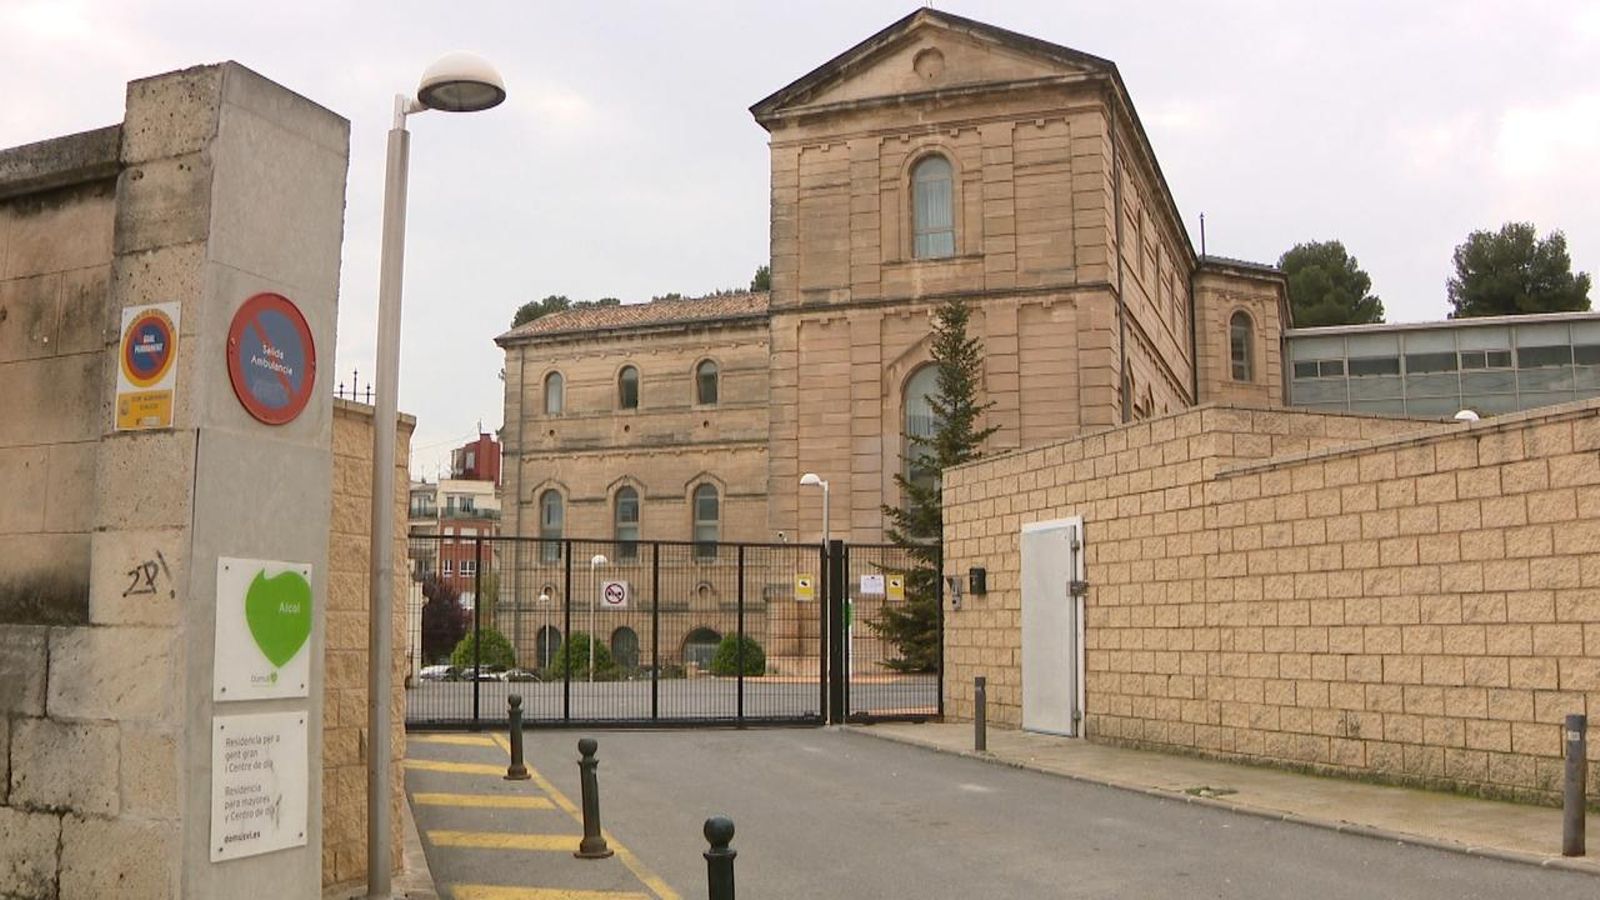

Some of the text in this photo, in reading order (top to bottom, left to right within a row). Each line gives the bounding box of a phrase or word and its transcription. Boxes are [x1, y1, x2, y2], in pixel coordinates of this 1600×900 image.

[262, 343, 284, 359] Salida
[250, 353, 294, 376] Ambulancia
[224, 749, 258, 761] gent gran
[229, 761, 252, 773] Centre
[253, 760, 262, 769] de
[224, 795, 270, 810] para mayores
[230, 809, 254, 820] Centro
[254, 808, 264, 818] de
